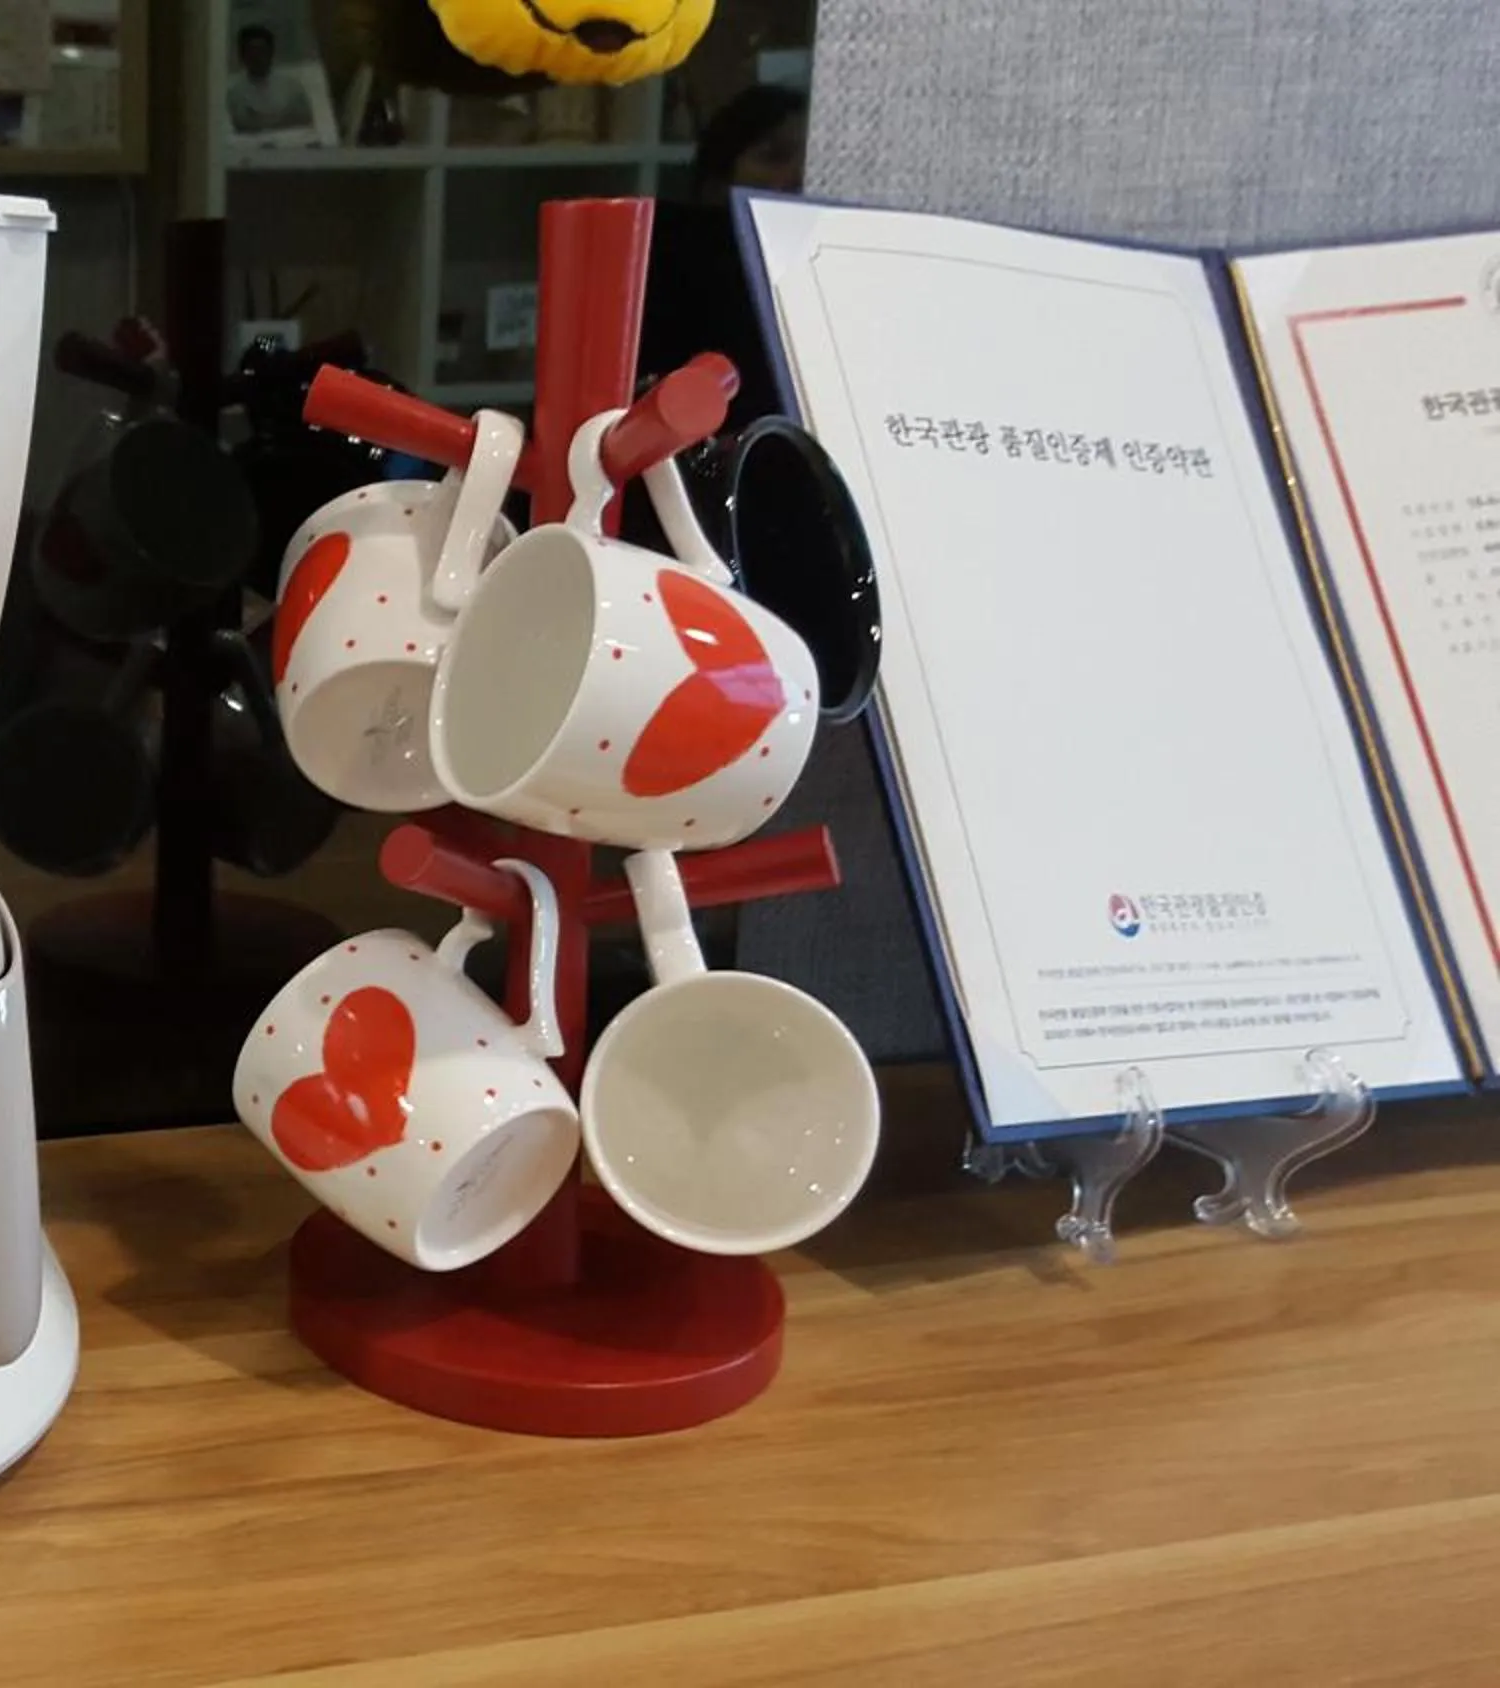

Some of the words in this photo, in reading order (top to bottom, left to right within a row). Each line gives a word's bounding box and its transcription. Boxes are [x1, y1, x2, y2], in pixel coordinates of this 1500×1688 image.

[884, 413, 990, 455] 한국관광
[1000, 424, 1117, 469] 품질인증제
[1121, 439, 1214, 479] 인증약관
